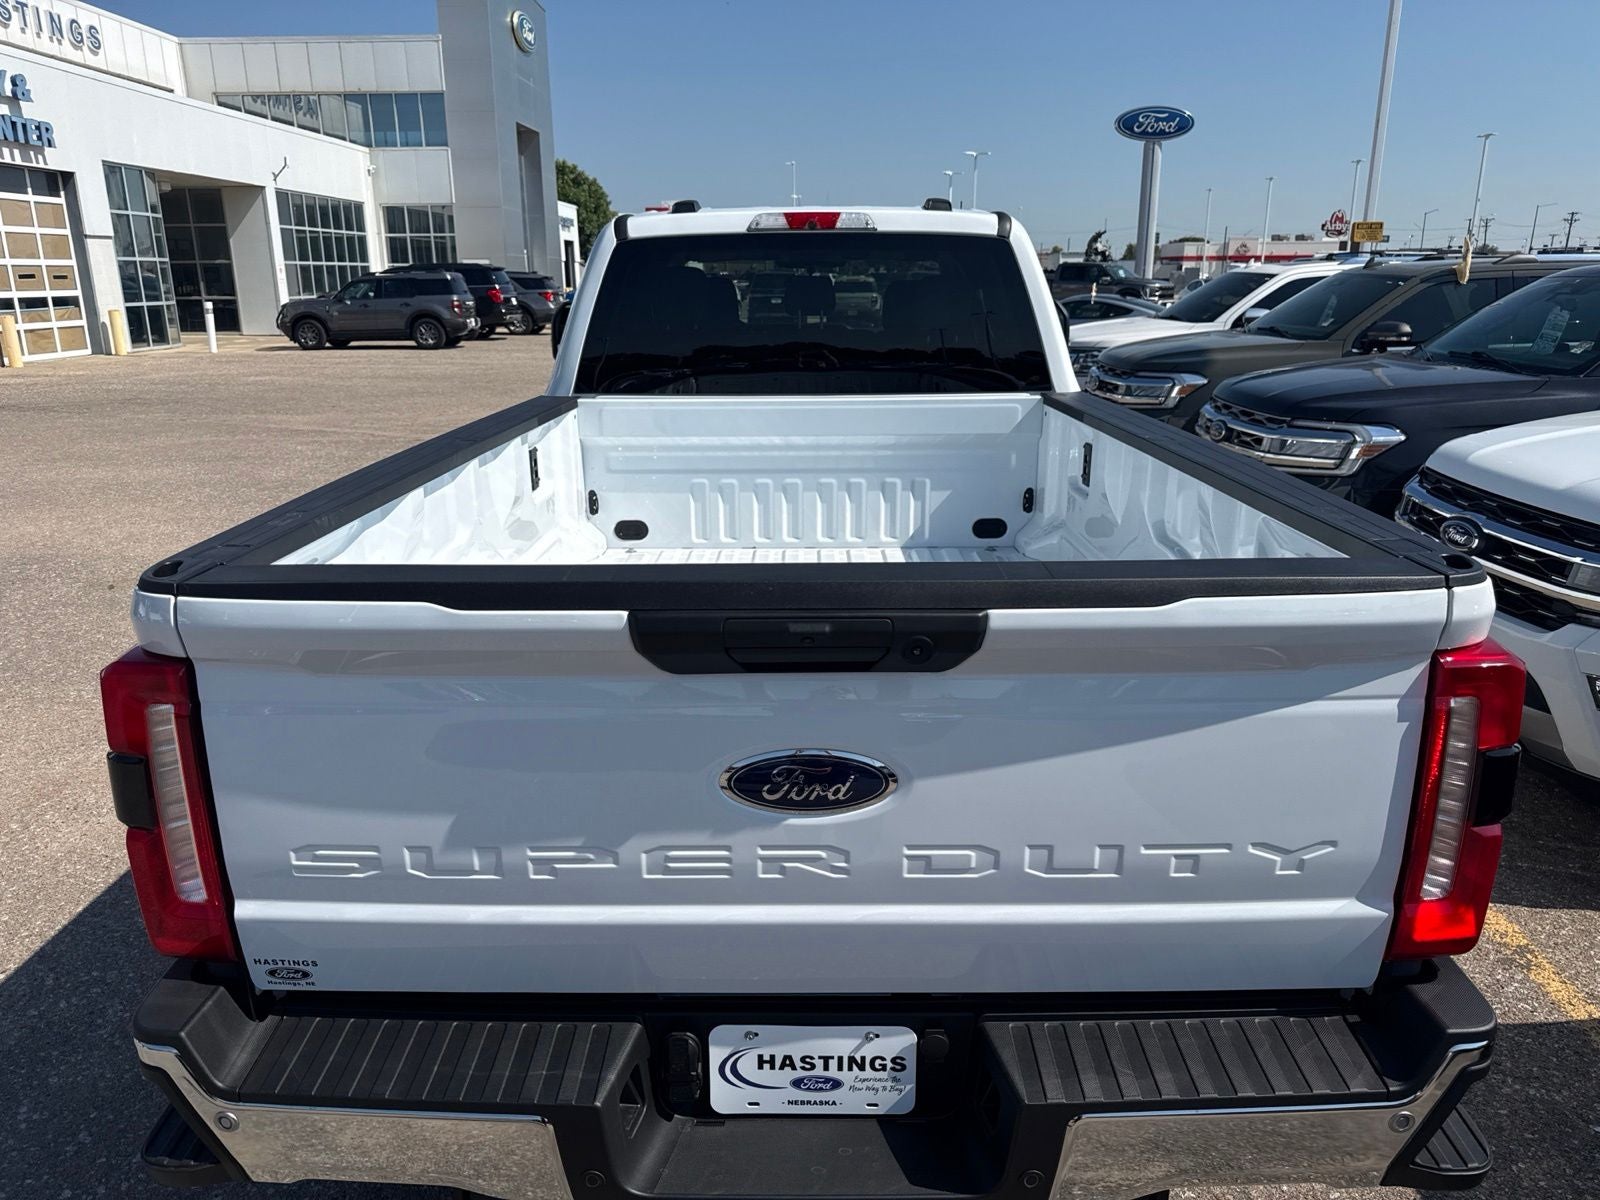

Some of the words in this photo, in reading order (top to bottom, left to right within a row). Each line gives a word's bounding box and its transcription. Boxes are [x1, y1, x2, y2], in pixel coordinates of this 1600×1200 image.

[0, 0, 102, 52] STINGS
[1133, 112, 1180, 133] Ford
[1445, 525, 1468, 544] Ford
[761, 765, 855, 801] Ford
[289, 843, 853, 880] SUPER
[902, 840, 1338, 878] DUTY
[253, 958, 319, 967] HASTINGS
[275, 969, 304, 979] Ford
[757, 1053, 908, 1073] HASTINGS
[800, 1078, 833, 1090] Ford
[853, 1075, 889, 1084] Experience
[890, 1075, 902, 1083] The
[848, 1084, 864, 1093] New
[865, 1083, 880, 1096] Way
[881, 1085, 888, 1093] To
[888, 1084, 907, 1096] Buy!
[787, 1099, 838, 1107] NEBRASKA
